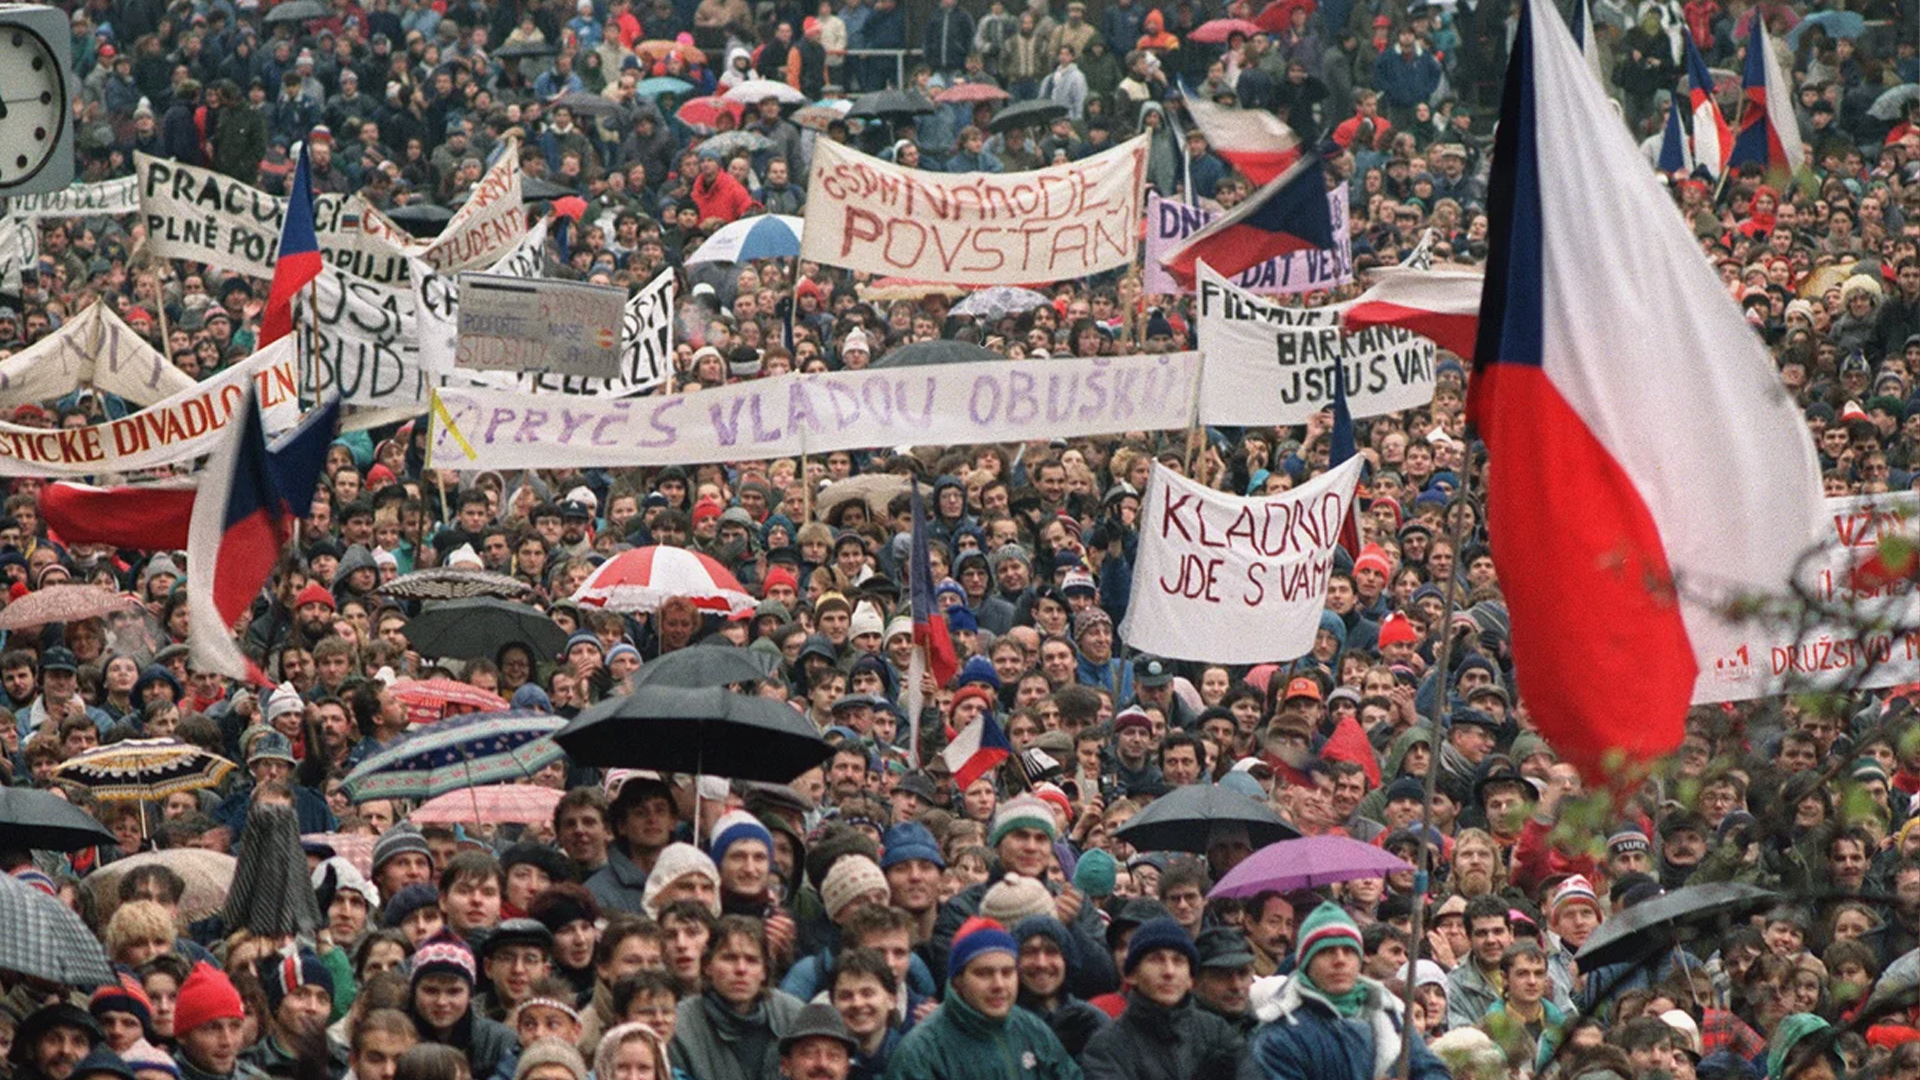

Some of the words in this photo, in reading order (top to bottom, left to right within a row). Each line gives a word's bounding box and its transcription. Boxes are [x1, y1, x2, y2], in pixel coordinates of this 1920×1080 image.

[147, 213, 219, 249] PLNĚ
[1367, 354, 1388, 394] S
[637, 397, 686, 448] S
[709, 374, 937, 447] VLÁDOU
[1163, 484, 1342, 557] KLADNO
[1160, 553, 1225, 603] JDE
[1244, 562, 1267, 607] S
[1771, 635, 1892, 676] DRUŽSTVO
